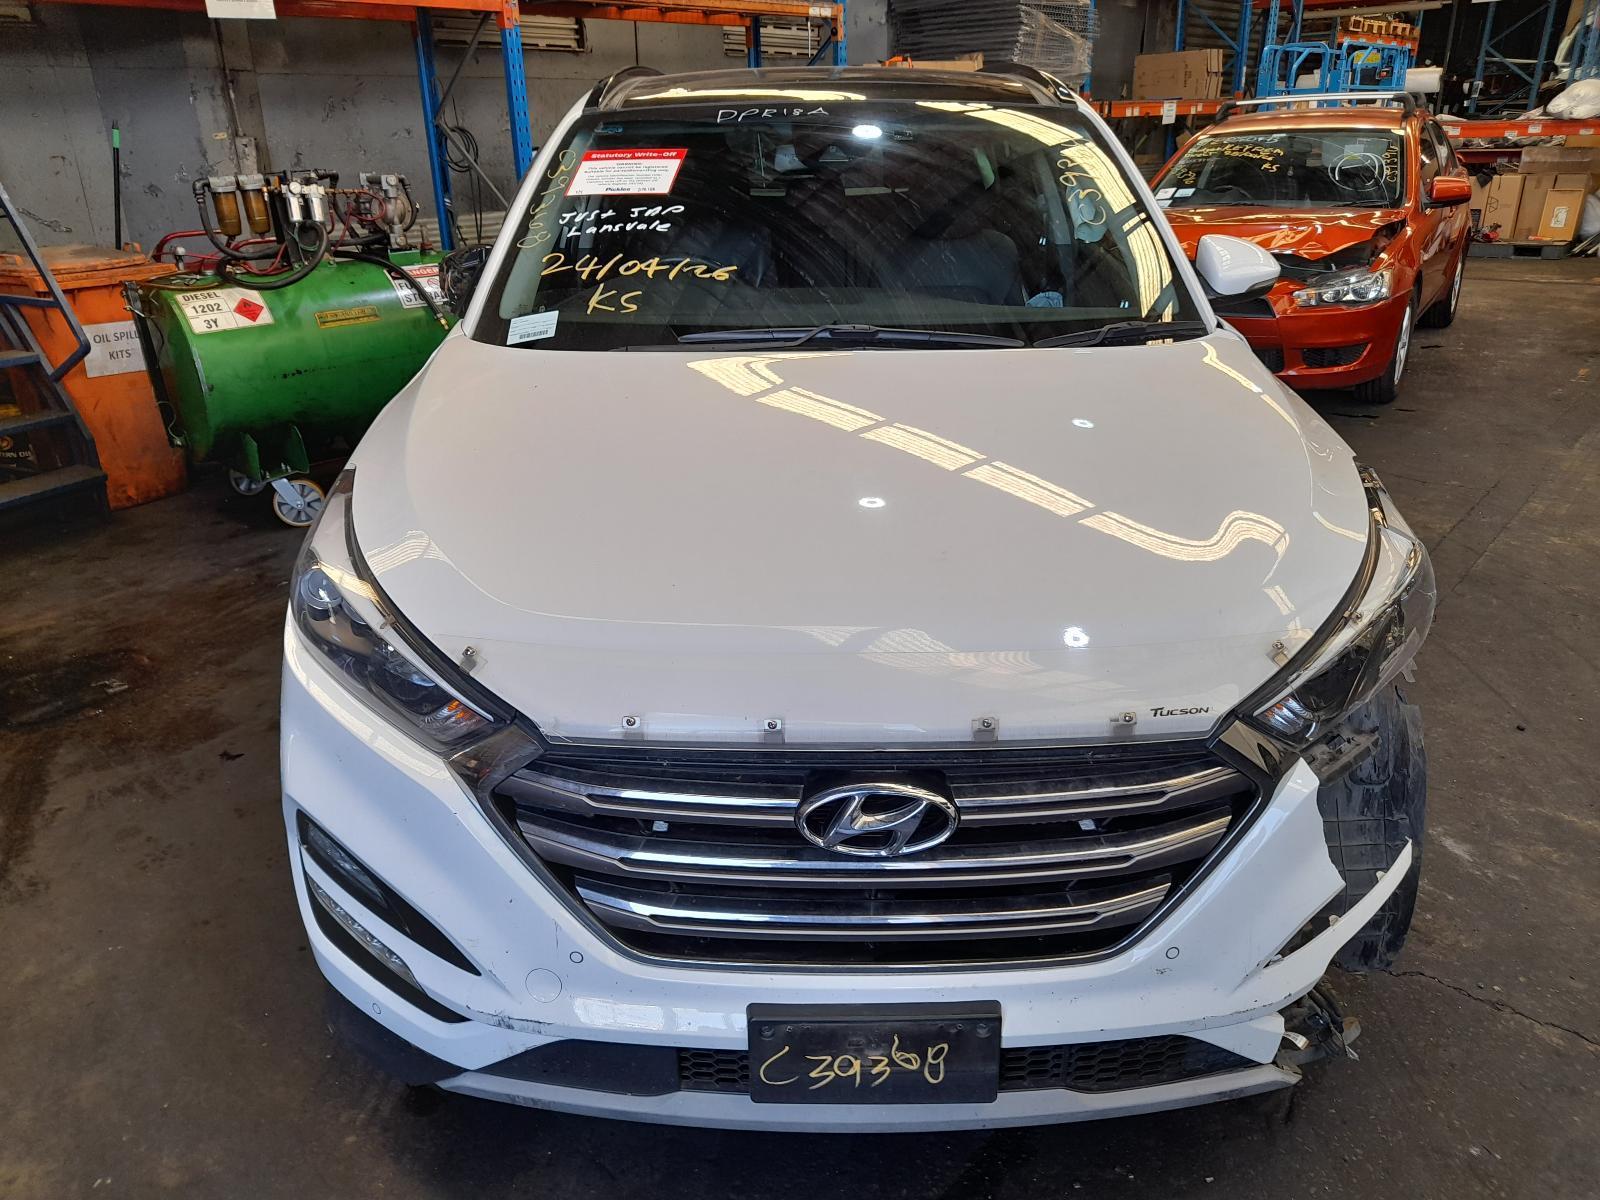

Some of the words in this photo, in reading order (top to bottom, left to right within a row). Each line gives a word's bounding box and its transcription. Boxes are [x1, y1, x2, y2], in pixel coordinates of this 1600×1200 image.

[591, 151, 632, 159] Statutory
[629, 205, 685, 219] JAP
[566, 219, 672, 238] Lansvale
[181, 291, 221, 302] DIESEL
[586, 282, 642, 315] KS
[191, 302, 223, 315] 1202
[203, 318, 220, 329] 3Y
[93, 333, 111, 344] OIL
[113, 330, 139, 343] SPILL
[108, 349, 132, 361] KITS
[1149, 706, 1210, 718] TUCSON
